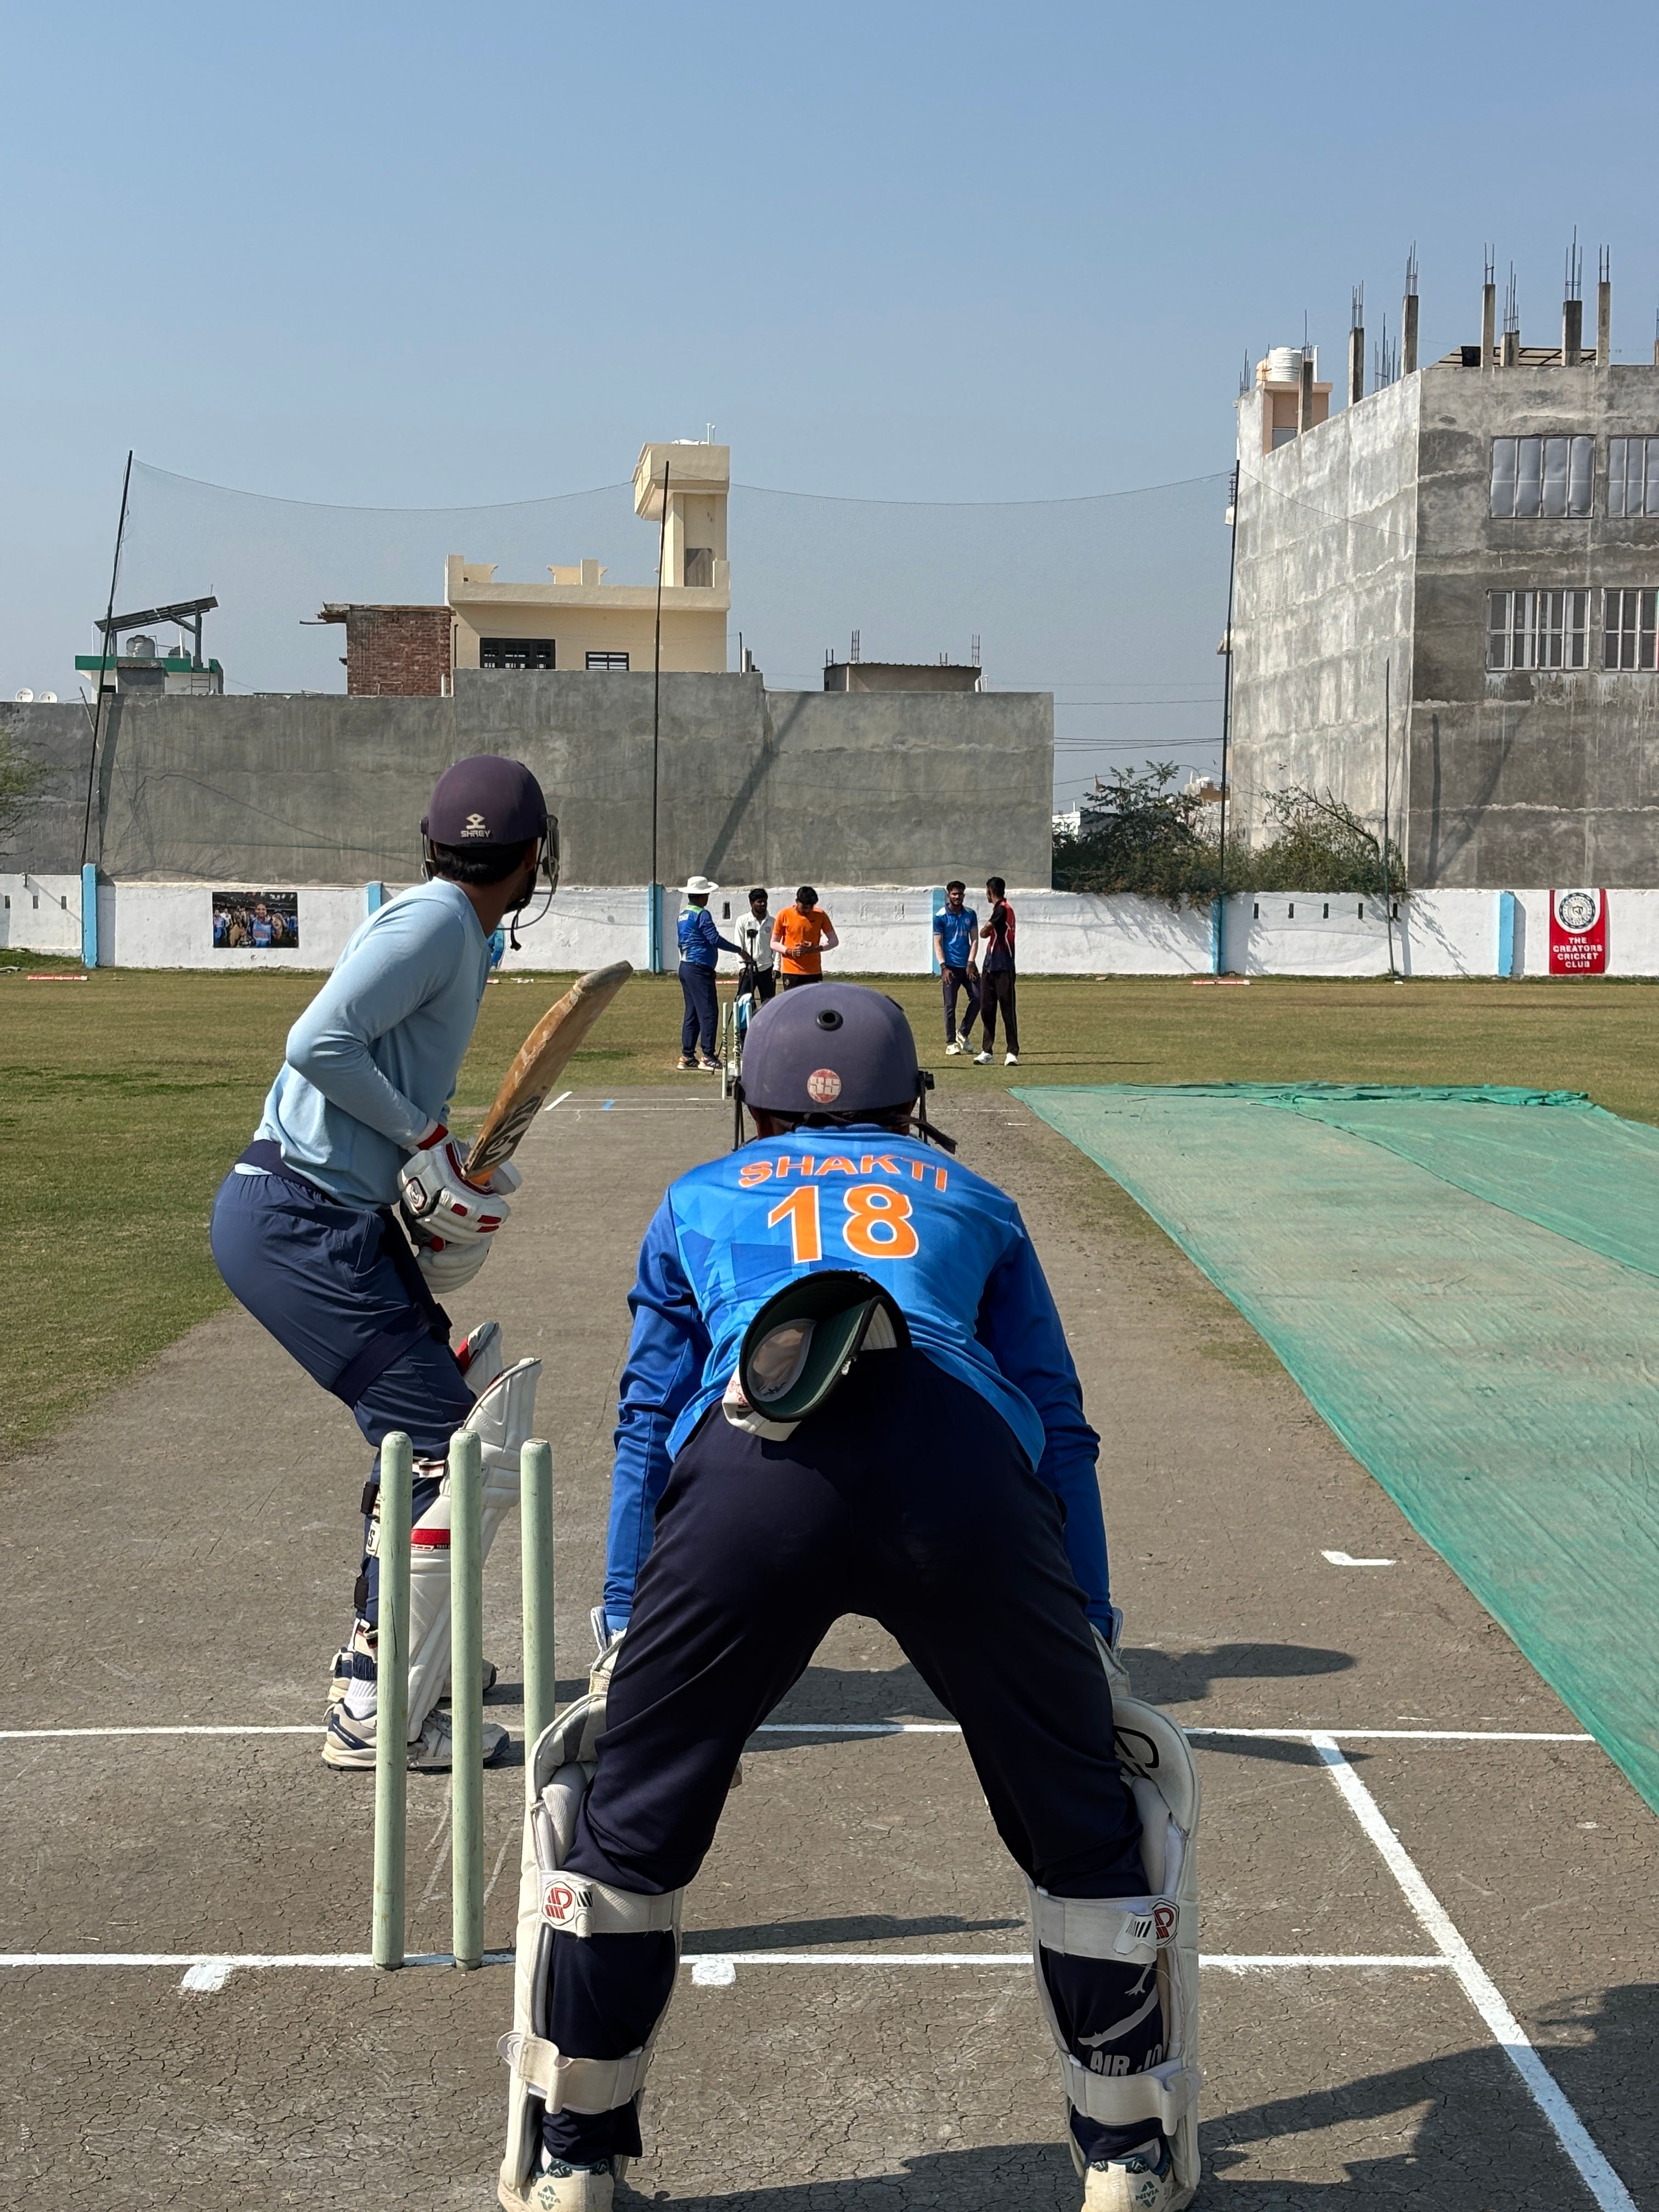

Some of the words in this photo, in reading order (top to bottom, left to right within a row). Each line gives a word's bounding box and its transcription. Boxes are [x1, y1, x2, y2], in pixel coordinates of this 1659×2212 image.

[738, 1154, 948, 1193] SHAKTI
[768, 1184, 919, 1264] 18
[1090, 2051, 1130, 2076] AIR
[537, 2191, 561, 2204] NIVIA
[1136, 2188, 1159, 2200] NIVIA
